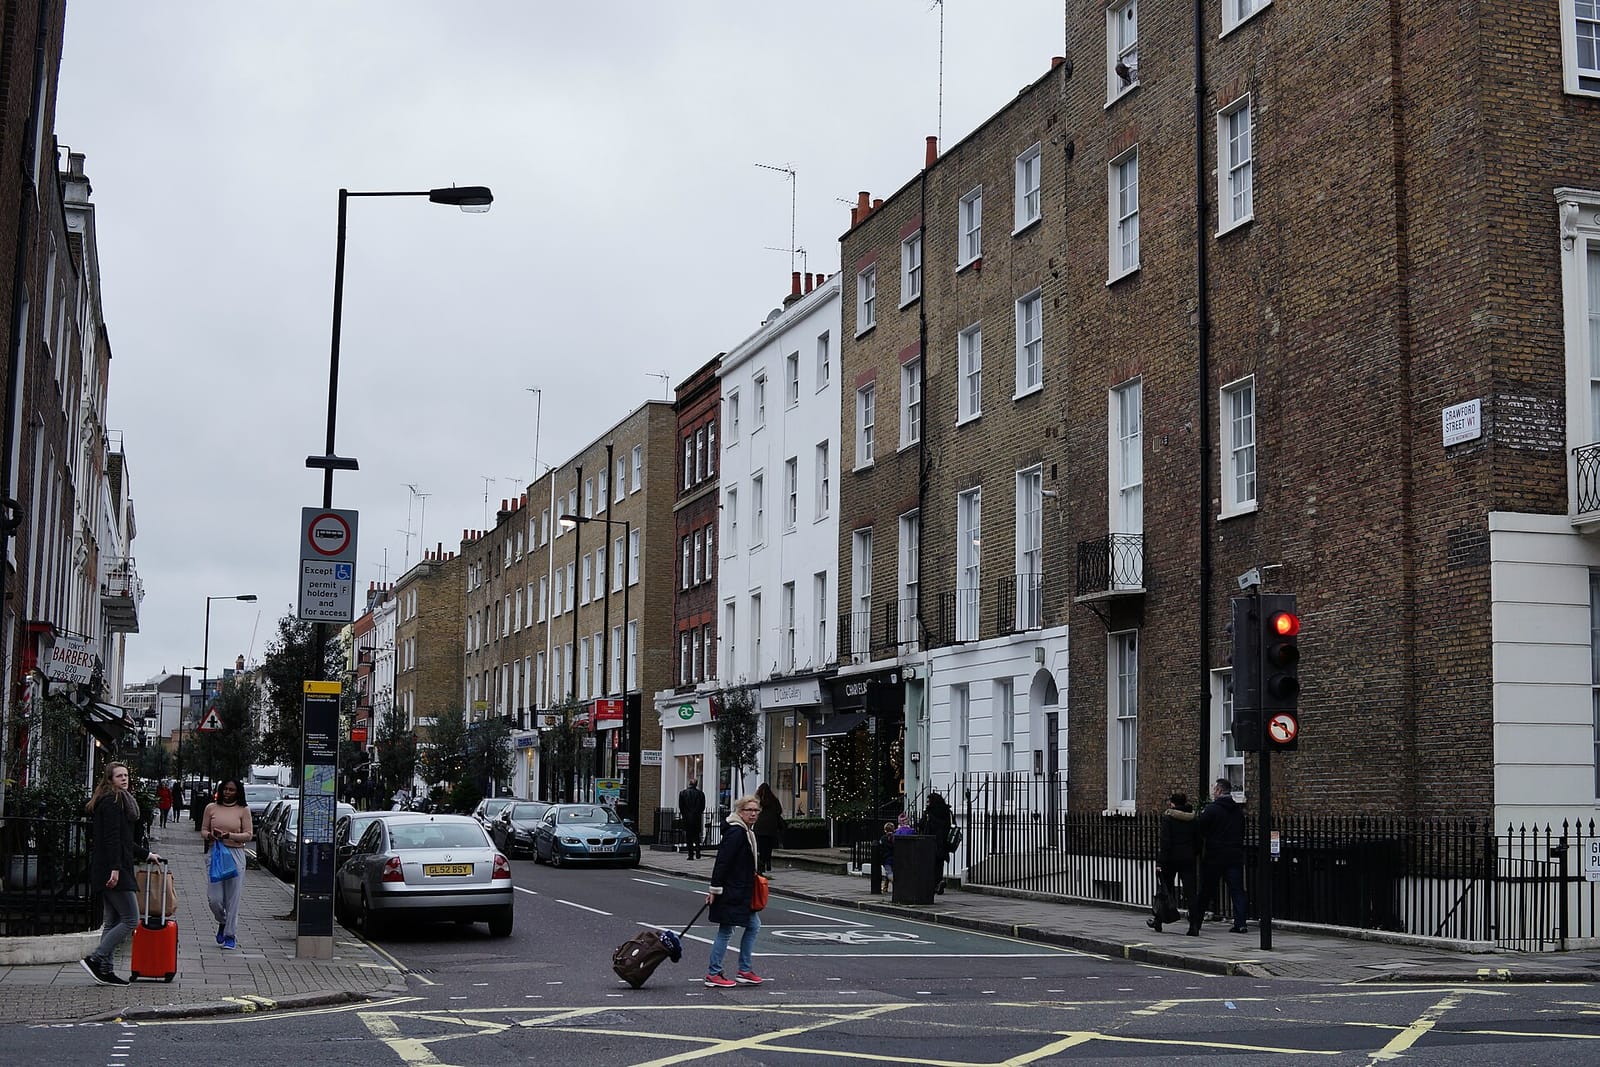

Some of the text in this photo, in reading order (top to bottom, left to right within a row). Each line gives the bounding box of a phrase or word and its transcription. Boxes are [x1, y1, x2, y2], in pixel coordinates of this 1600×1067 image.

[1446, 404, 1475, 421] CRAWFORD
[1446, 416, 1475, 432] STREET W1
[305, 567, 333, 575] Except
[307, 590, 338, 598] holders
[53, 646, 94, 669] BARBERS
[65, 664, 78, 674] 020
[1591, 842, 1600, 853] G
[430, 865, 450, 873] GL52
